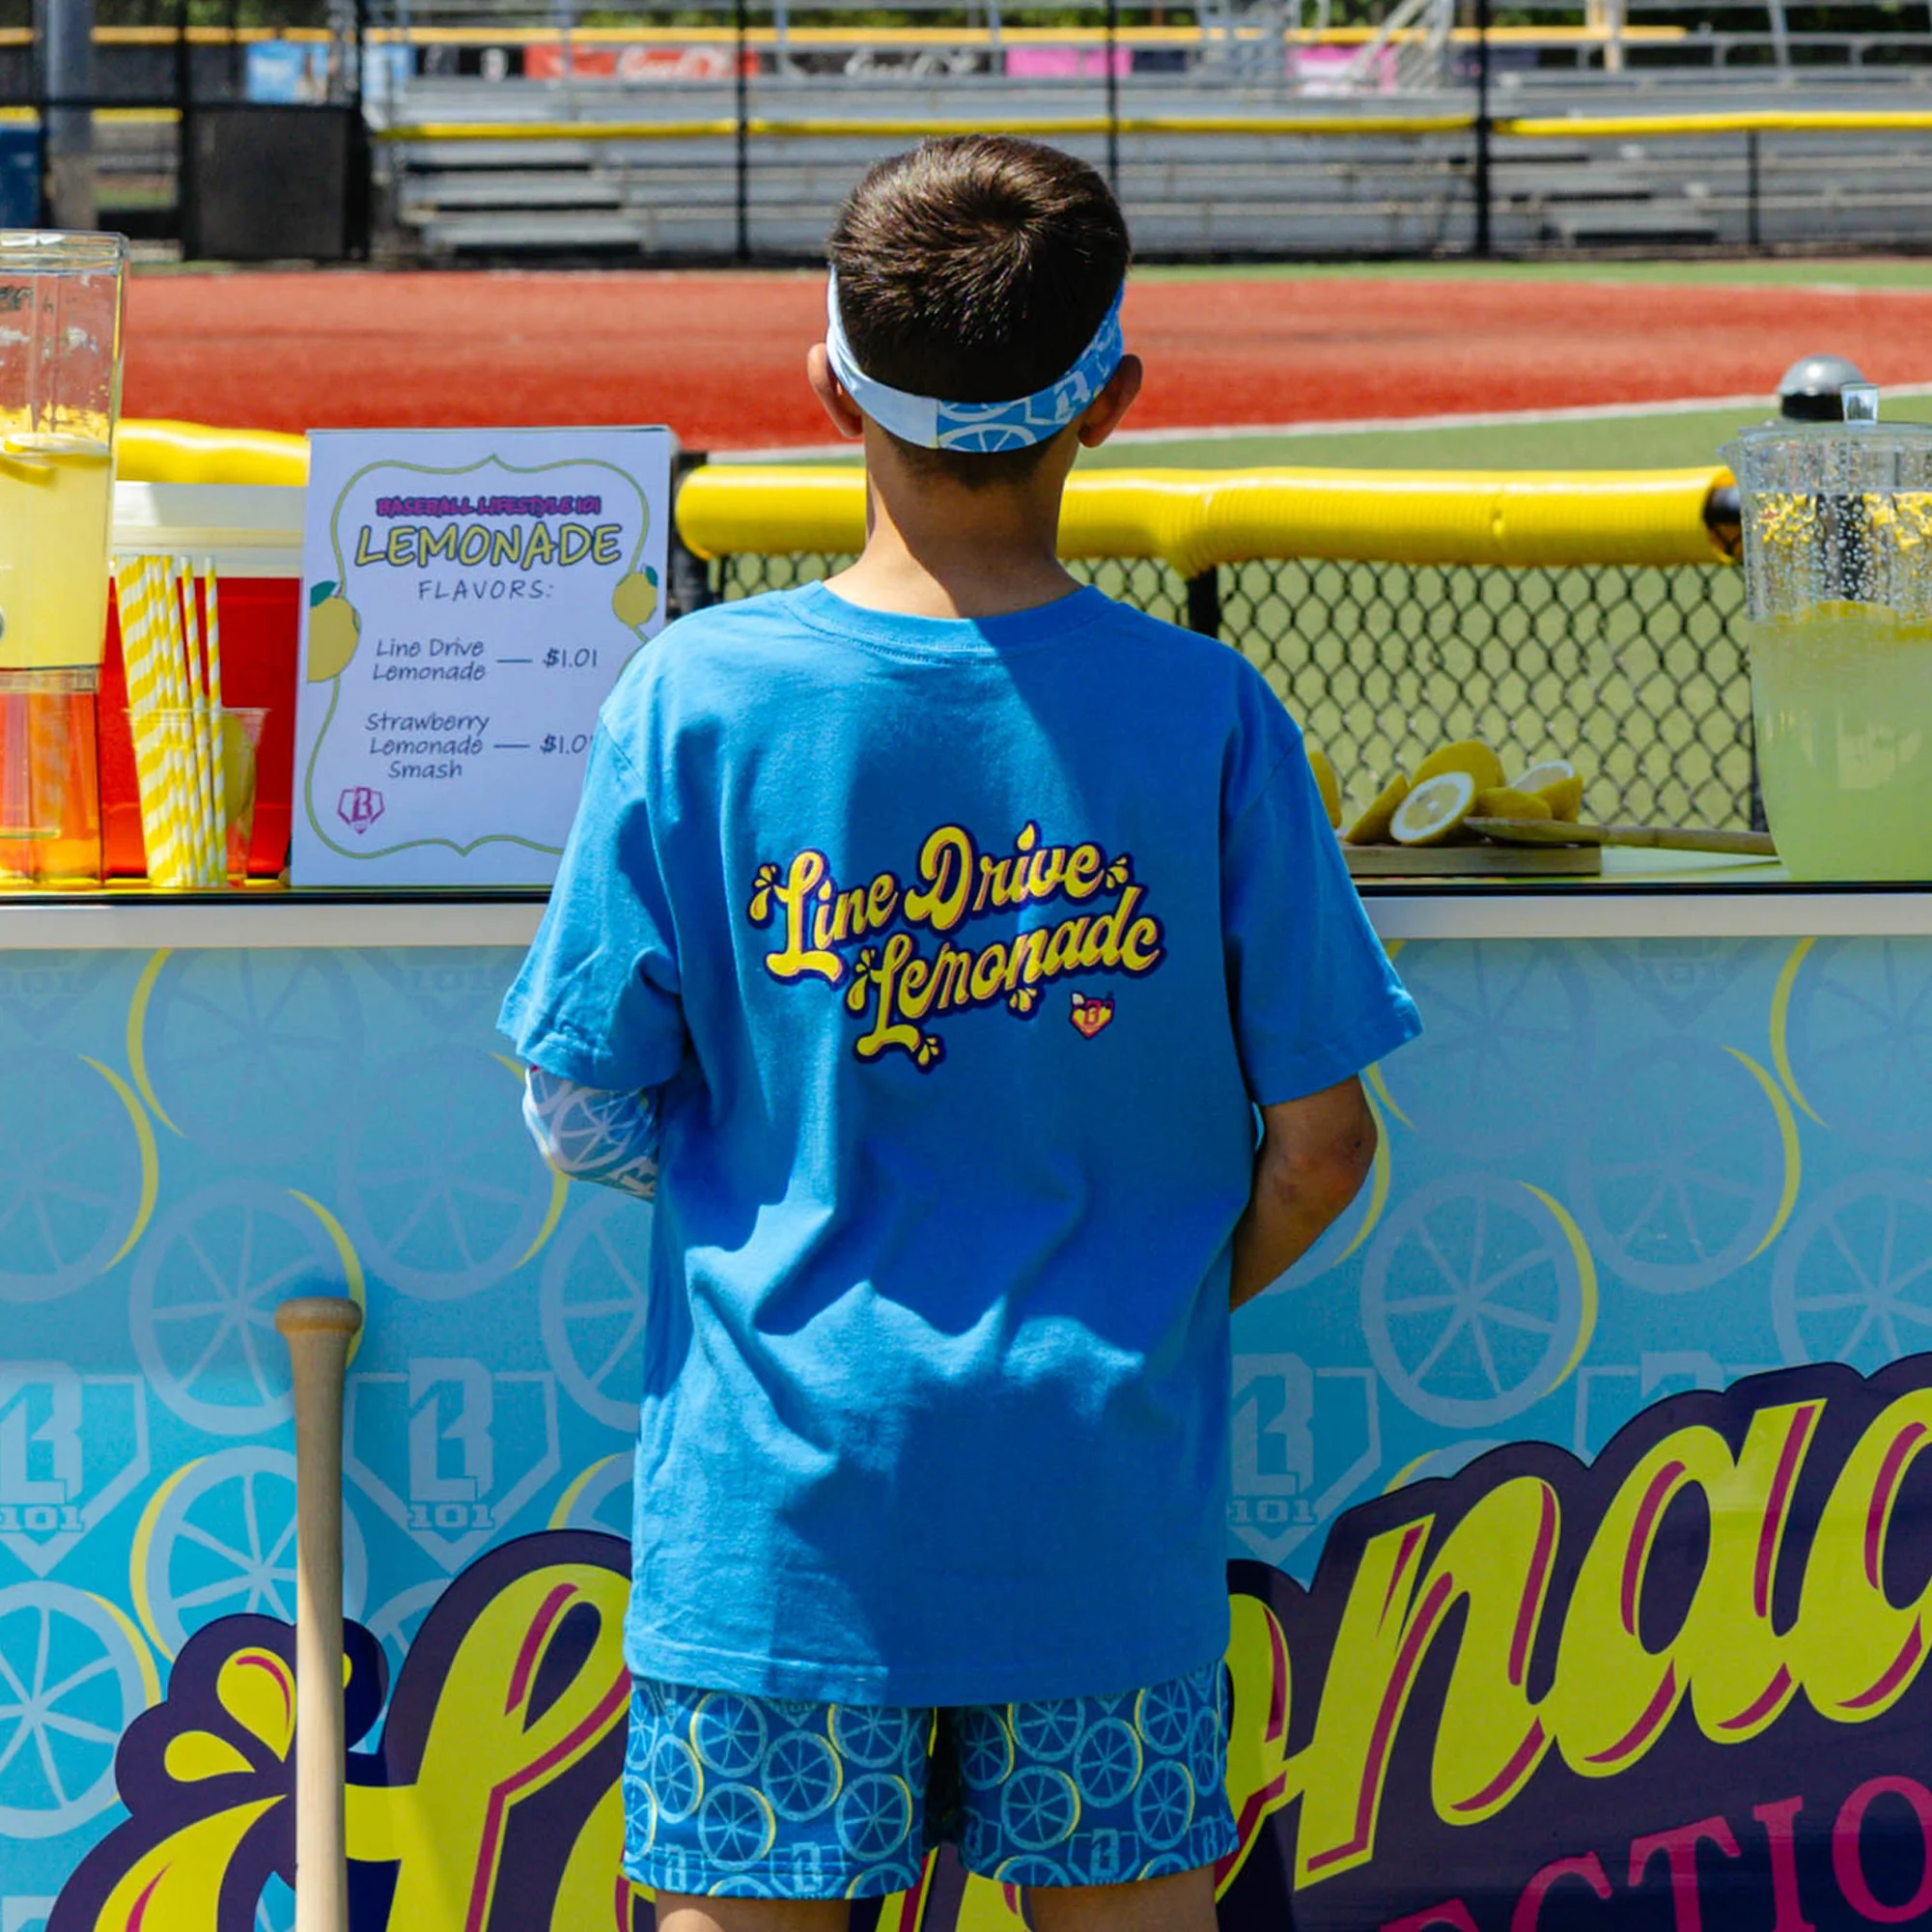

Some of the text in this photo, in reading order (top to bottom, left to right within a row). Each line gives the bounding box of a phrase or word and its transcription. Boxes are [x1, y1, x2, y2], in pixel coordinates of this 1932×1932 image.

[377, 495, 601, 518] BASEBALL LIFESTYLE 101
[355, 521, 623, 571] LEMONADE
[418, 579, 554, 602] FLAVORS:
[376, 636, 485, 658] Line Drive
[543, 647, 599, 668] $1.01
[372, 661, 487, 682] Lemonade
[365, 712, 490, 737] Strawberry
[370, 737, 484, 756] Lemonade
[387, 759, 463, 779] Smash
[767, 822, 1103, 983] Line Drive
[856, 885, 1161, 1057] Lemonade
[409, 1502, 495, 1529] 101
